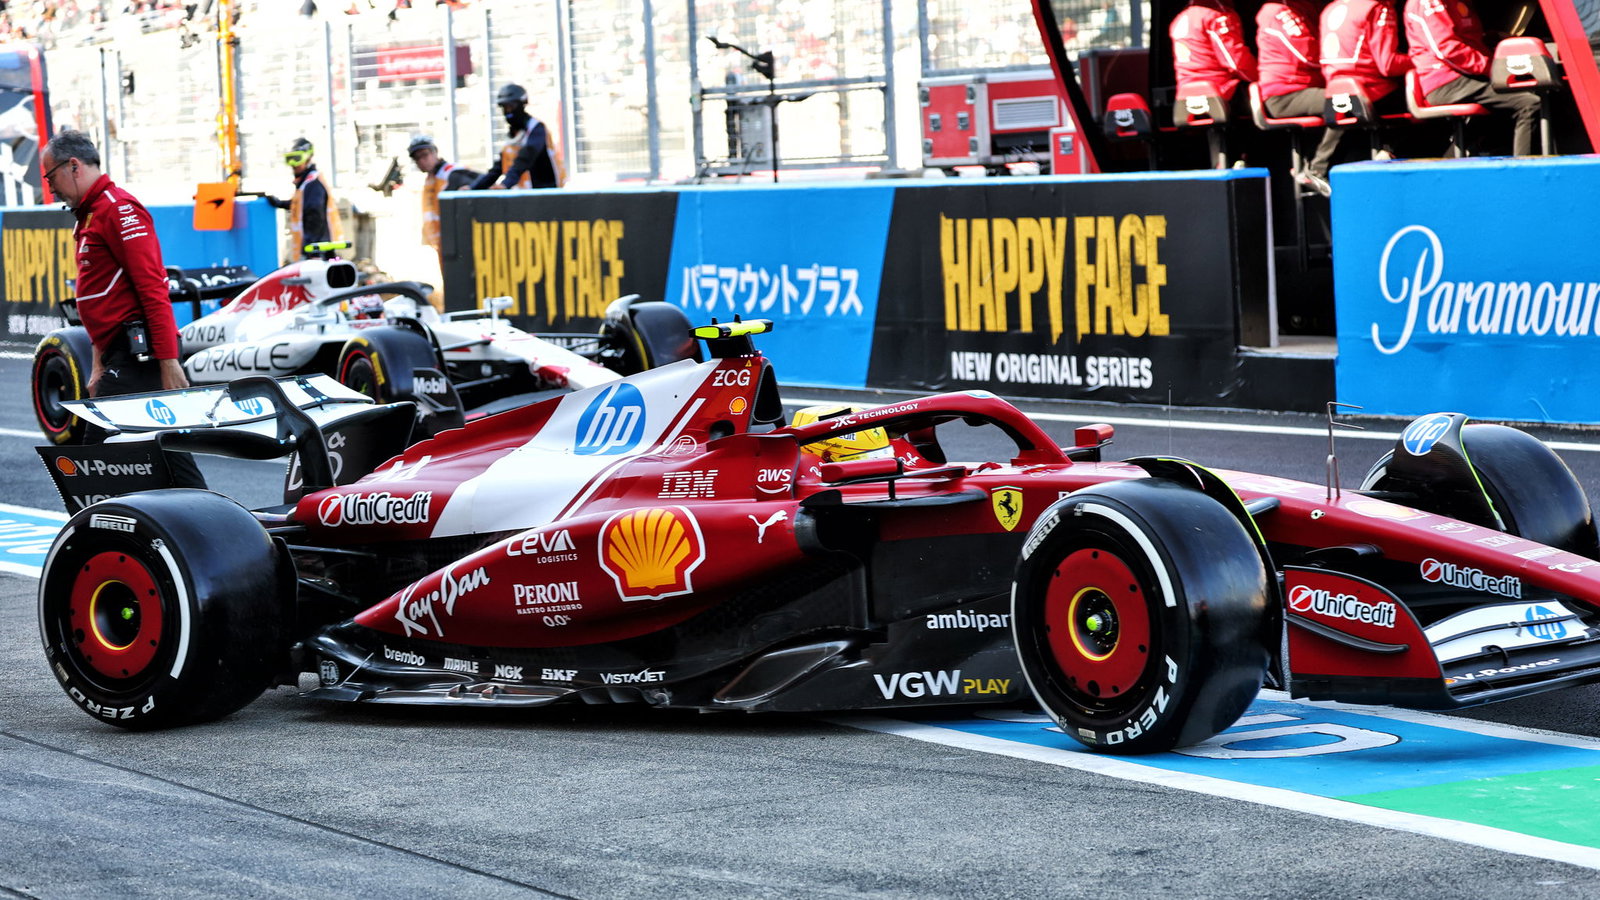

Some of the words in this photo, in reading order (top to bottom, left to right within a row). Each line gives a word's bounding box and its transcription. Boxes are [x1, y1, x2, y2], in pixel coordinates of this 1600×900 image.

[3, 227, 56, 309] HAPPY
[471, 217, 558, 326] HAPPY
[562, 218, 625, 325] FACE
[940, 212, 1067, 345] HAPPY
[1074, 213, 1170, 344] FACE
[681, 263, 864, 317] パラマウントプラス
[182, 326, 226, 342] ONDA
[193, 343, 298, 372] ORACLE
[951, 351, 992, 381] NEW
[996, 354, 1082, 386] ORIGINAL
[1085, 356, 1153, 389] SERIES
[413, 377, 447, 394] Mobil
[712, 369, 751, 387] ZCG
[149, 399, 172, 425] hp
[578, 383, 643, 455] hp
[830, 415, 856, 429] DXC
[858, 403, 919, 420] TECHNOLOGY
[1407, 418, 1447, 453] hp
[77, 459, 153, 476] V-Power
[757, 469, 791, 483] aws
[657, 469, 718, 498] IBM
[343, 492, 431, 523] UniCredit
[89, 513, 137, 533] PIRELLI
[1022, 509, 1060, 561] PIRELLI
[537, 553, 578, 564] LOGISTICS
[1441, 561, 1521, 599] UniCredit
[513, 582, 580, 606] PERONI
[517, 606, 545, 615] NASTRO
[547, 603, 583, 613] AZZURRO
[542, 614, 572, 627] 0.0%
[926, 609, 1010, 632] ambipar
[1312, 589, 1396, 628] UniCredit
[384, 645, 425, 666] brembo
[443, 657, 479, 673] MAHLE
[320, 665, 336, 680] FIA
[494, 664, 523, 680] NGK
[541, 668, 578, 682] SKF
[600, 668, 666, 684] VISTAJET
[1165, 654, 1178, 684] P
[1457, 657, 1560, 680] V-Power
[873, 669, 961, 700] VGW
[963, 678, 1011, 694] PLAY
[68, 687, 135, 719] ZERO
[141, 695, 155, 714] P
[1106, 685, 1170, 745] ZERO
